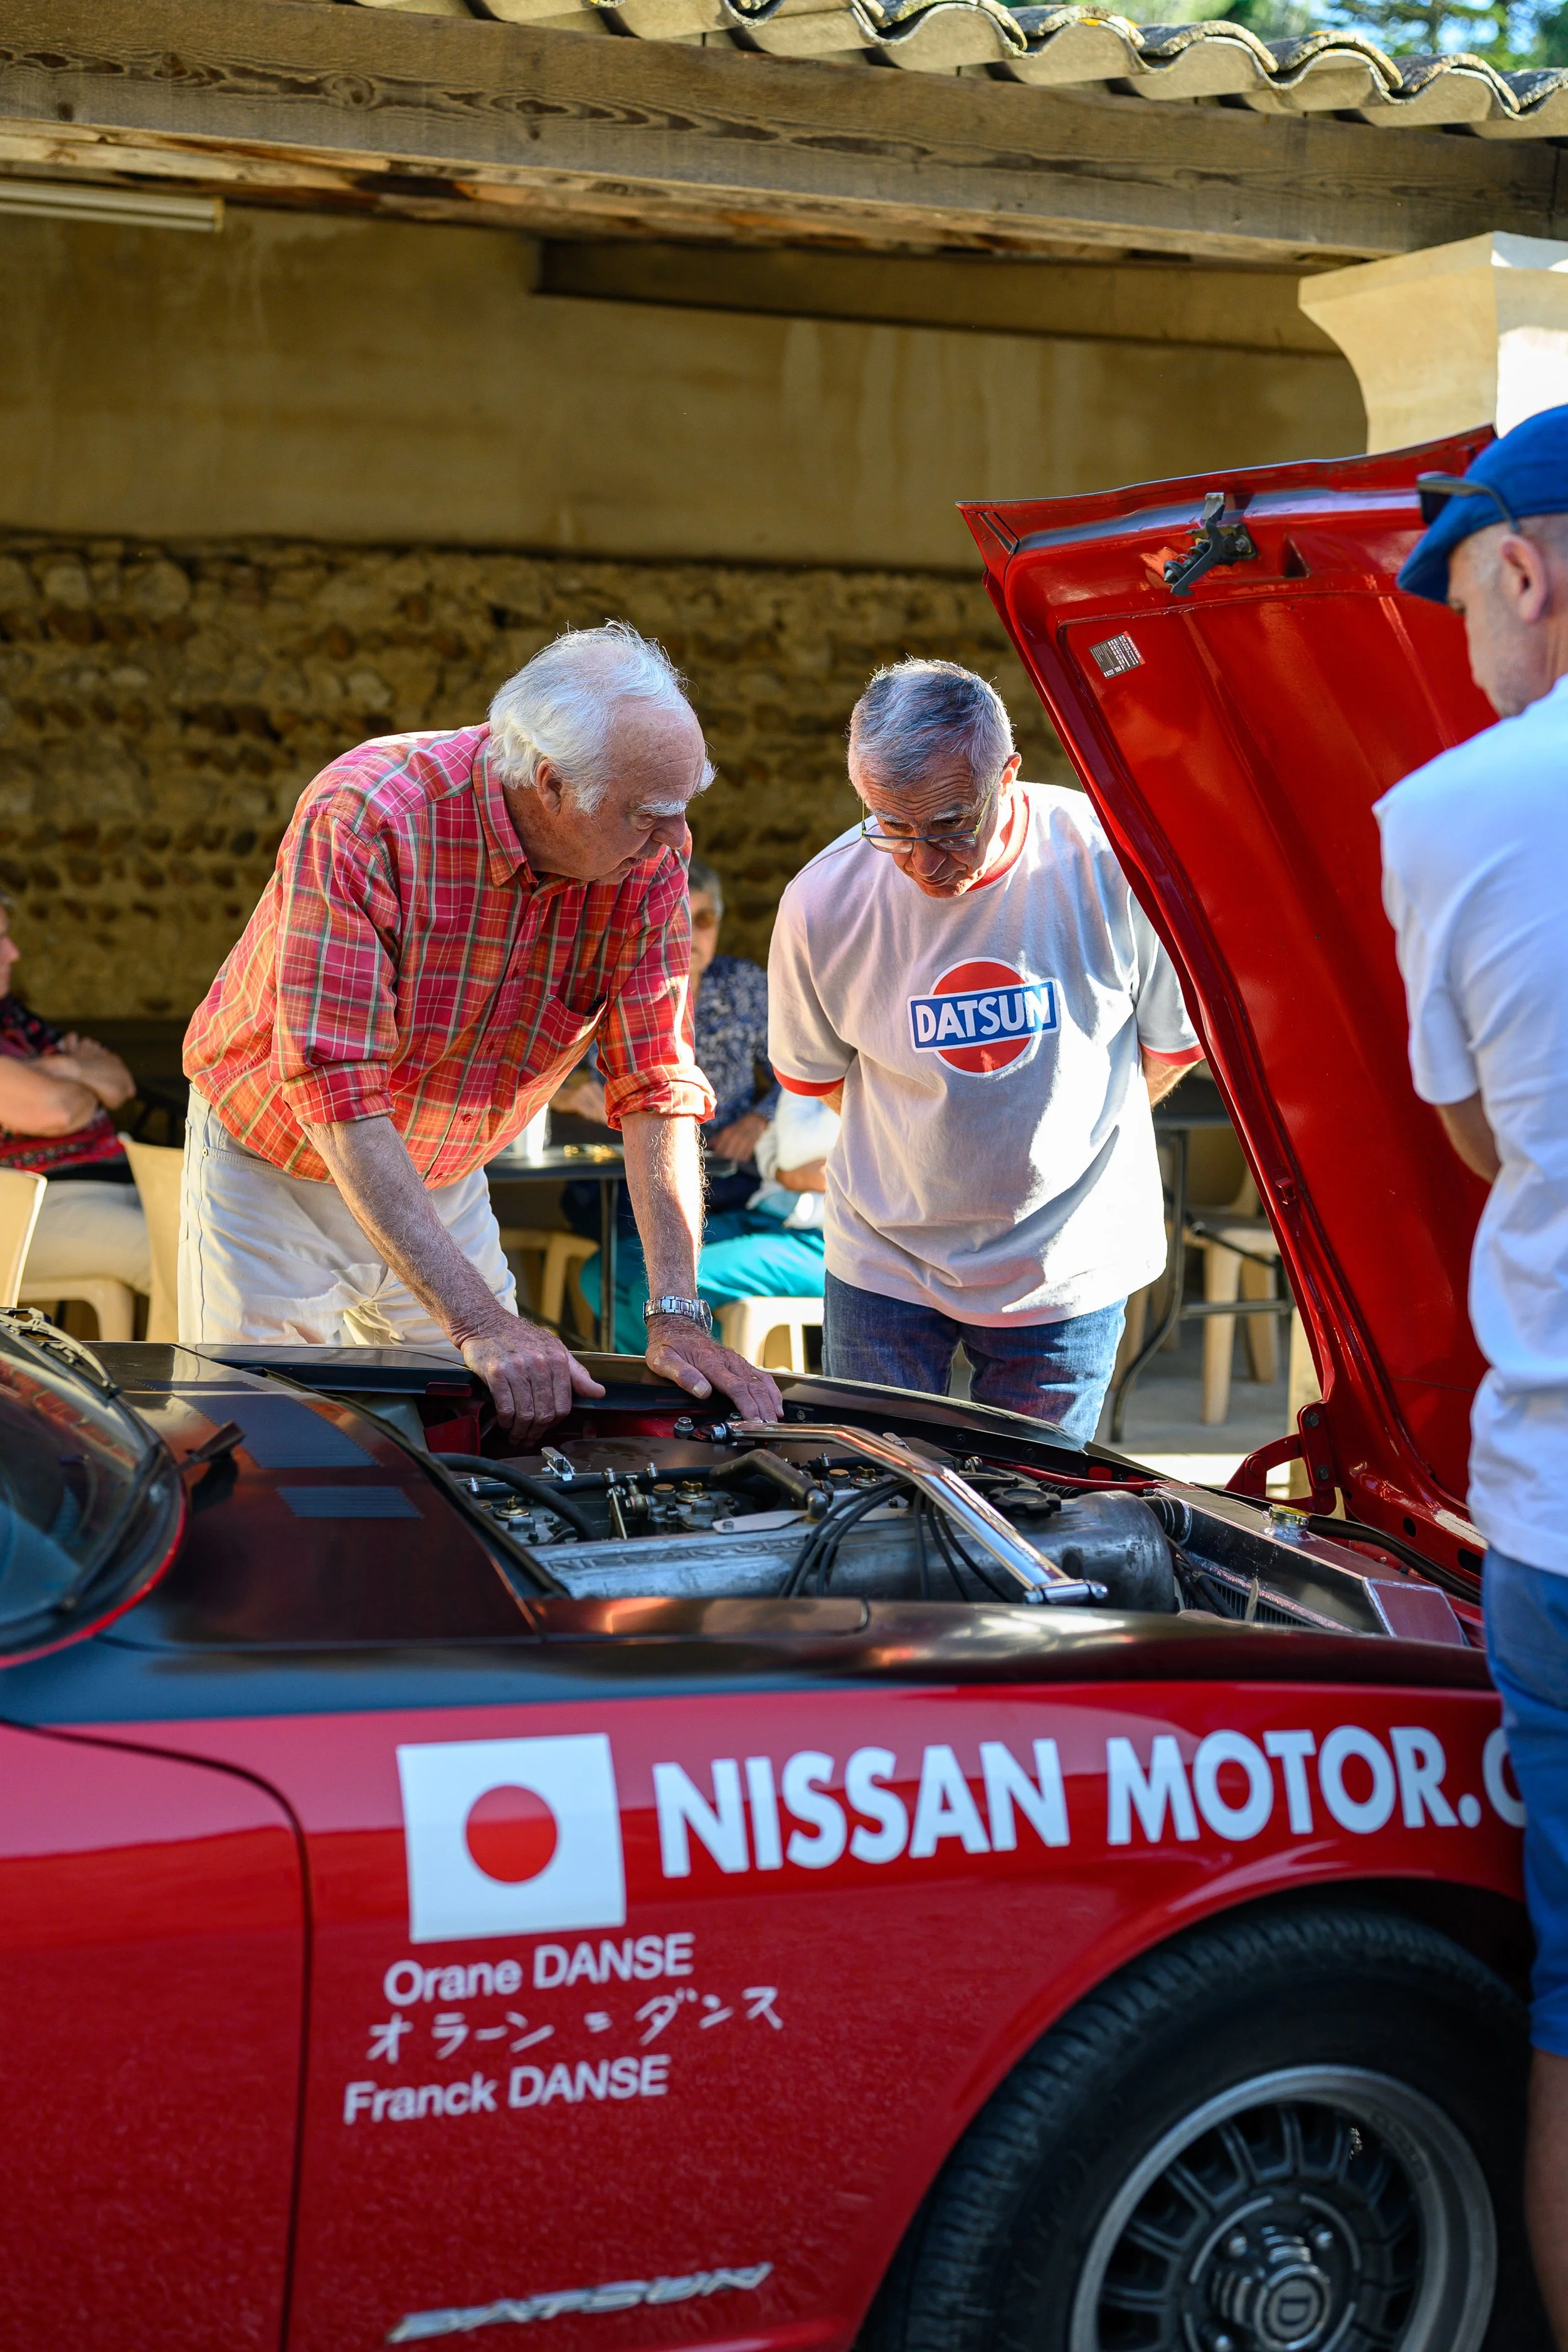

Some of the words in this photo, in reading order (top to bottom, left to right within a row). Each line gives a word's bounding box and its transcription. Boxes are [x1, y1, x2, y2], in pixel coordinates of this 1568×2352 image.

[1126, 637, 1142, 659] MOTUL
[915, 987, 1051, 1042] DATSUN
[652, 1737, 1069, 1877] NISSAN
[384, 1959, 522, 2006] Orane
[533, 1932, 695, 1989] DANSE
[344, 2072, 497, 2124] Franck
[508, 2053, 670, 2109] DANSE
